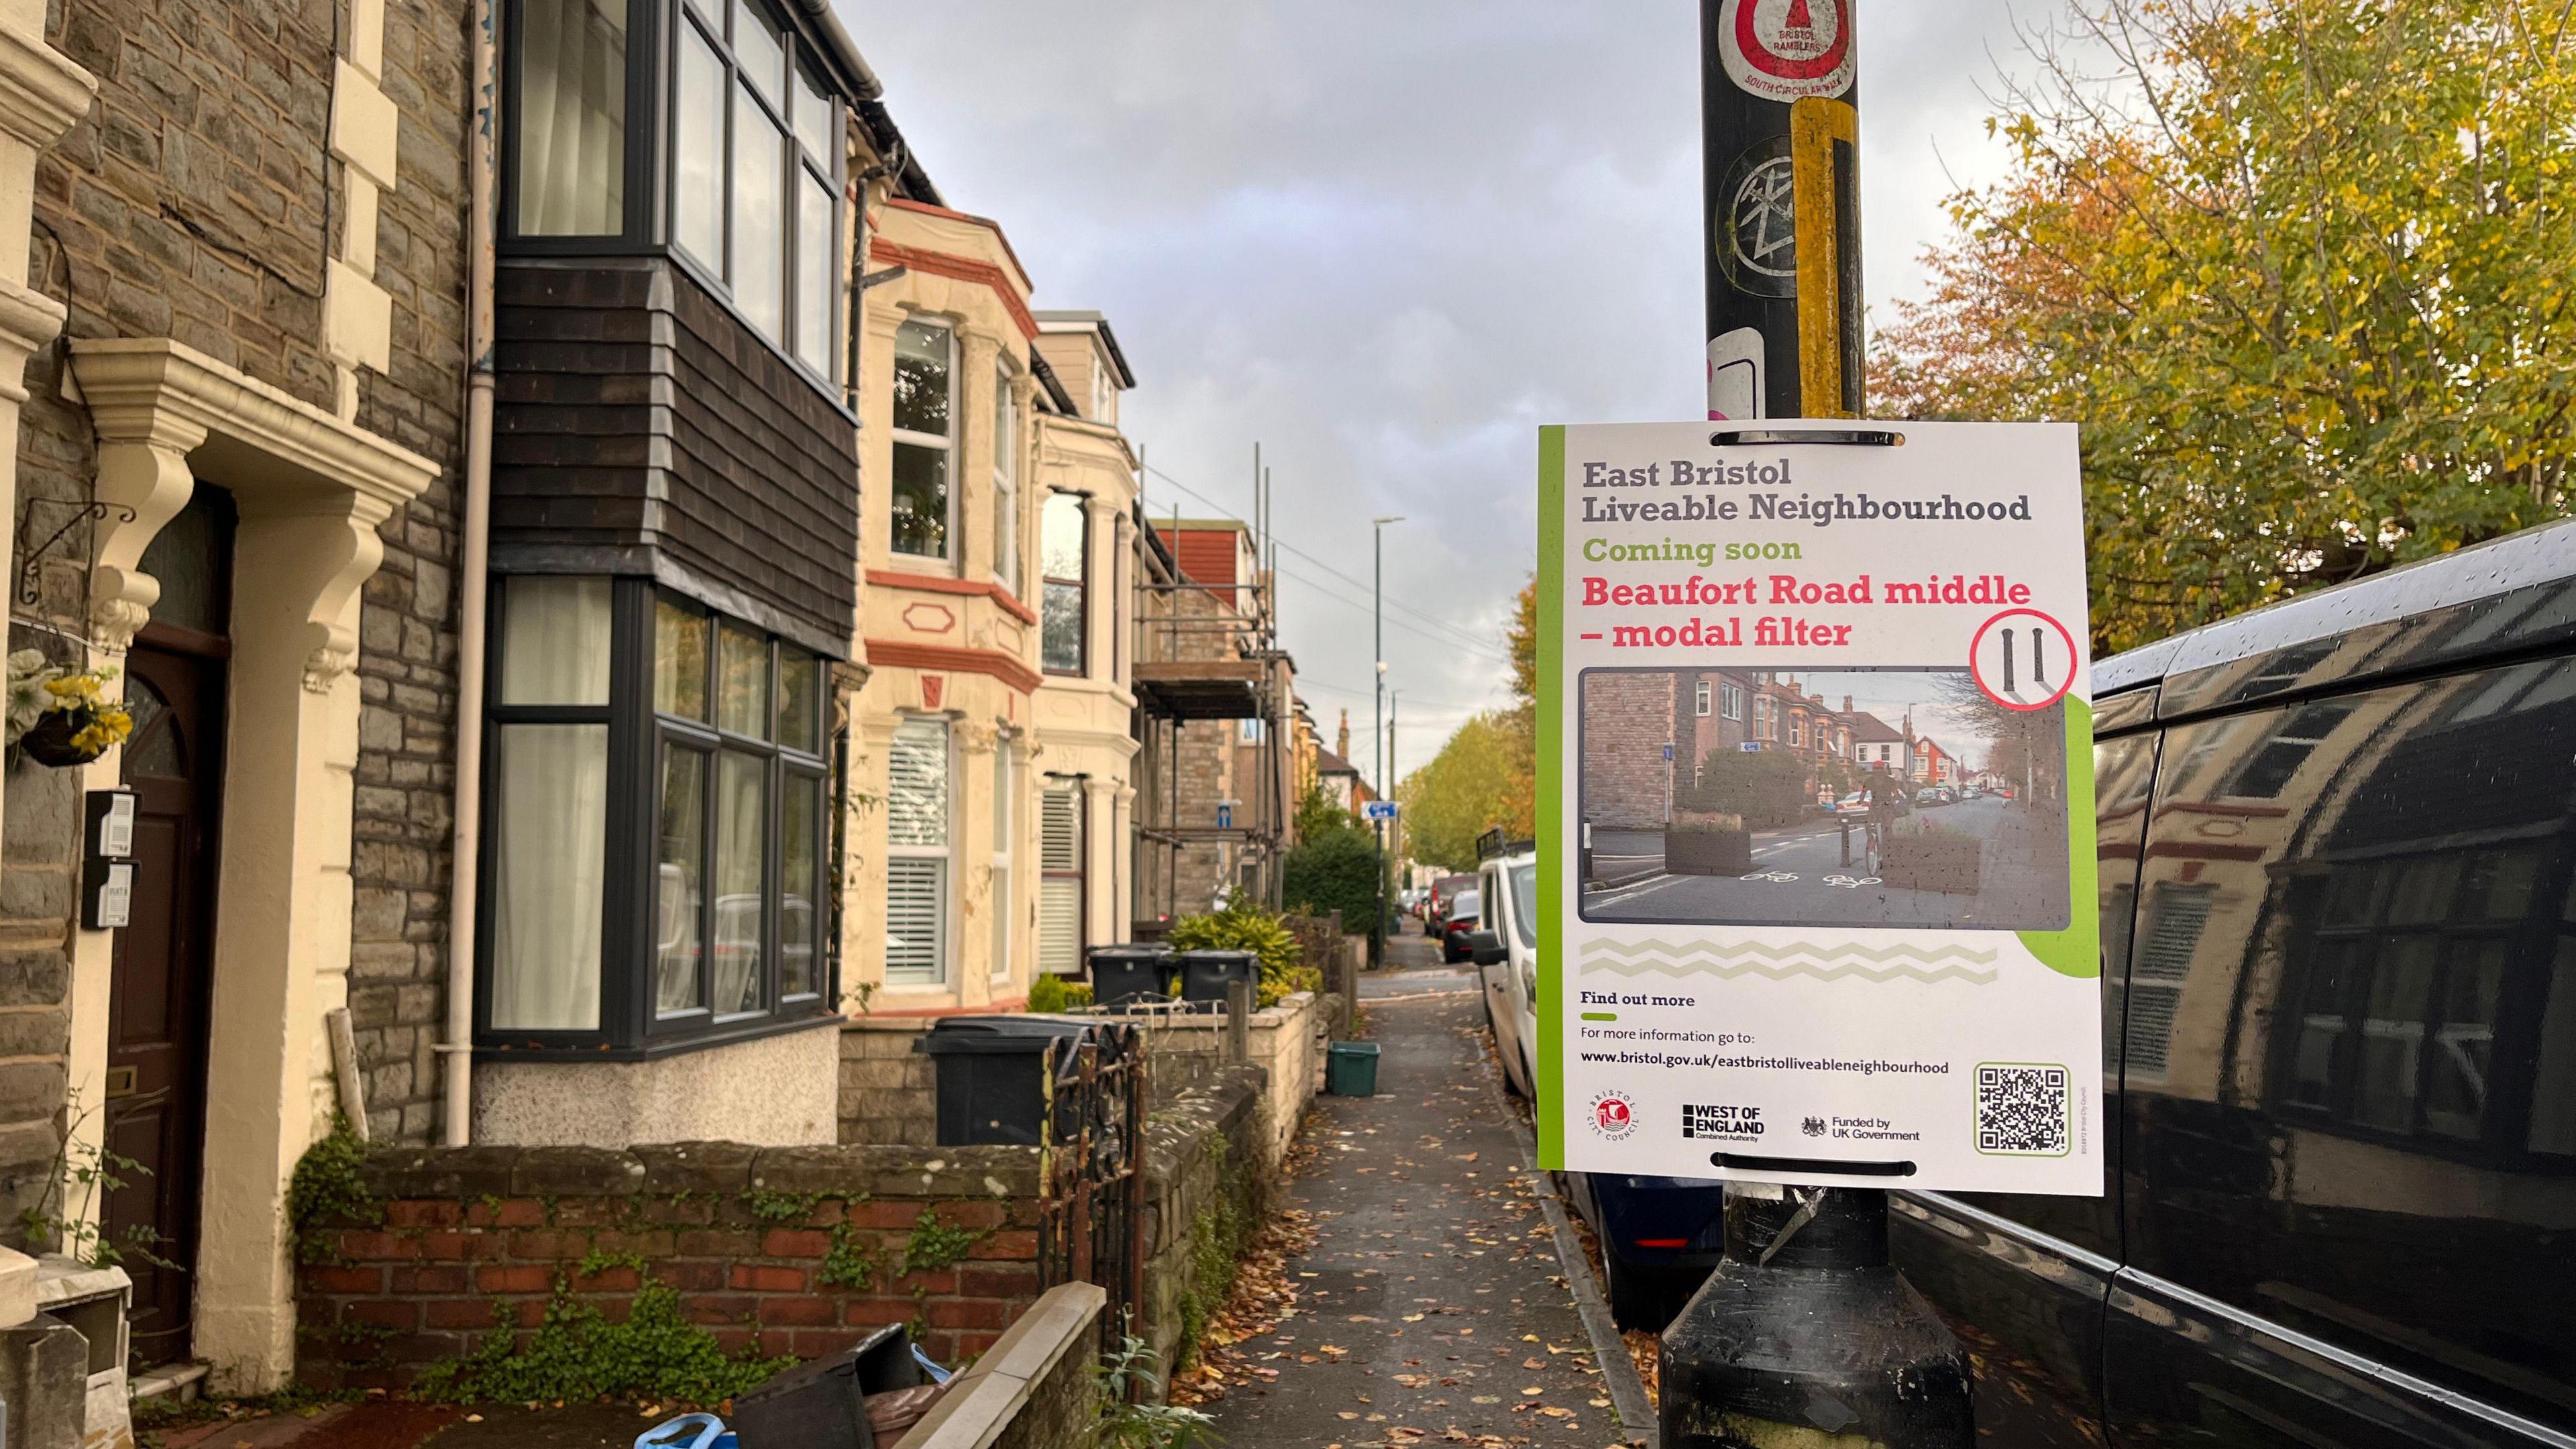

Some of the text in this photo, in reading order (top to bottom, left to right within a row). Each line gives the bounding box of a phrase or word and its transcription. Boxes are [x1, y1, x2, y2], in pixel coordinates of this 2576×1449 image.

[1779, 30, 1817, 40] BRISTOL
[1774, 42, 1821, 52] RAMBLERS
[1746, 74, 1774, 93] SOUTH
[1776, 84, 1821, 95] CIRCULAR
[1582, 458, 1792, 488] East Bristol
[1582, 493, 2031, 527] Liveable Neighbourhood
[1582, 537, 1803, 568] Coming soon
[1582, 575, 2031, 606] Beaufort Road middle
[1612, 617, 1743, 647] modal
[1754, 616, 1852, 646] filter
[1580, 991, 1695, 1007] Find out more
[1581, 1026, 1755, 1046] For more information go to:
[1580, 1051, 1949, 1075] www.bristol.gov.uk/eastbristolliveableneighbourhood
[1590, 1089, 1635, 1108] BRISTOL
[1695, 1105, 1760, 1120] WEST OF
[1587, 1116, 1640, 1141] CITY COUNCIL
[1696, 1119, 1764, 1134] ENGLAND
[1833, 1117, 1890, 1130] Funded by
[1695, 1132, 1758, 1142] Combined Authority
[1833, 1129, 1920, 1140] UK Government
